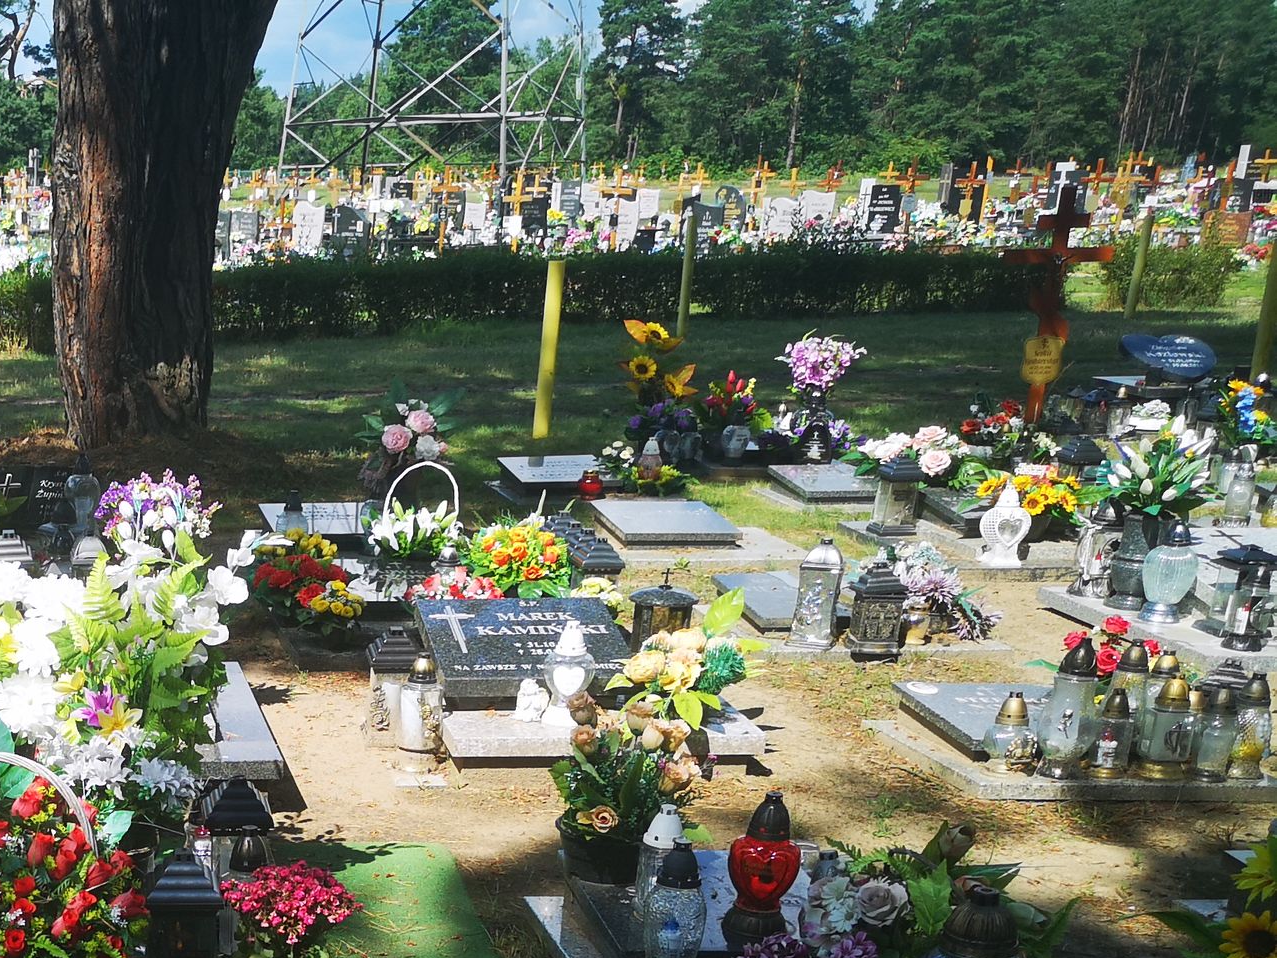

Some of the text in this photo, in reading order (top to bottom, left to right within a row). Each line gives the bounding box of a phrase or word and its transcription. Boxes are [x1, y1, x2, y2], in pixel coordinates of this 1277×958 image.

[496, 611, 576, 621] MAREK
[475, 622, 610, 636] KAMIŃKI
[454, 664, 471, 672] NA
[473, 663, 518, 671] ZAWSZE
